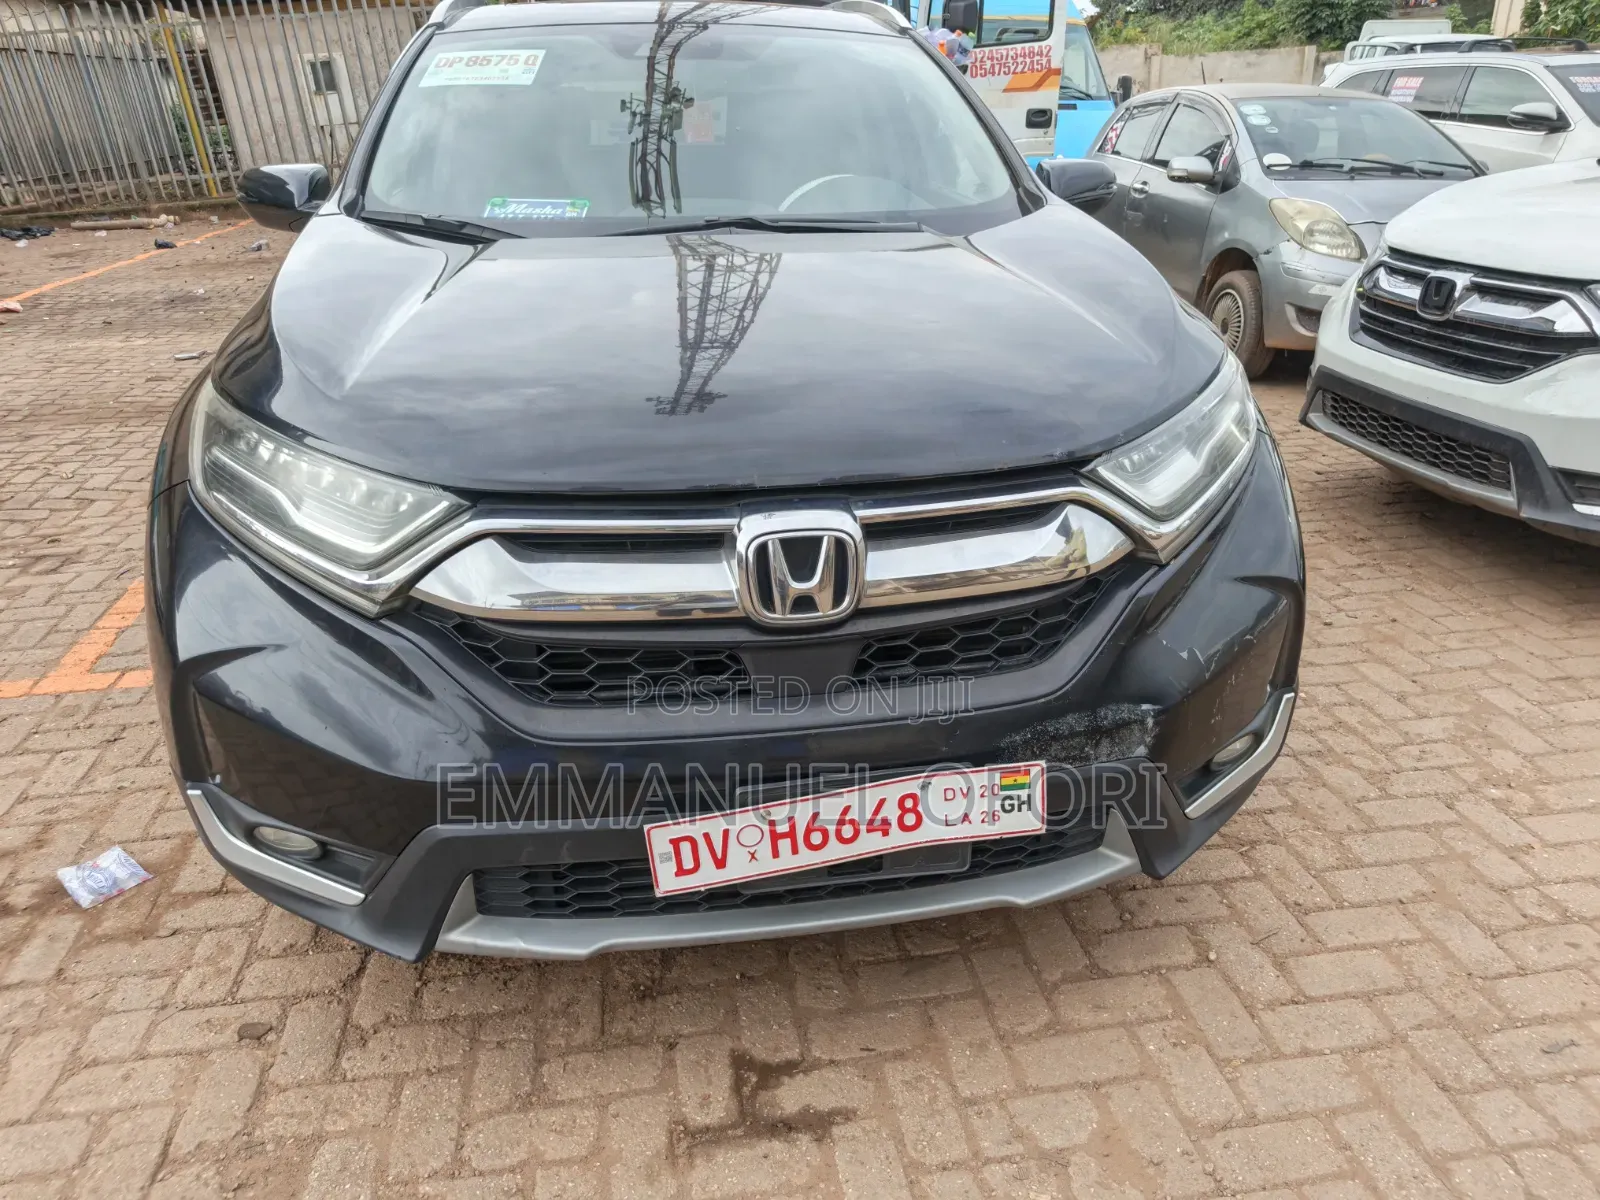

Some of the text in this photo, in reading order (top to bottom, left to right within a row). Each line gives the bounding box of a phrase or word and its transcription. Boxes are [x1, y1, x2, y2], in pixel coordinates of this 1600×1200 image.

[435, 53, 540, 68] DP 8575 Q
[970, 58, 1052, 78] 0547522454
[943, 783, 1000, 802] DV 20
[1000, 794, 1032, 814] GH
[944, 810, 1000, 827] LA 26
[669, 792, 923, 877] DV H6648
